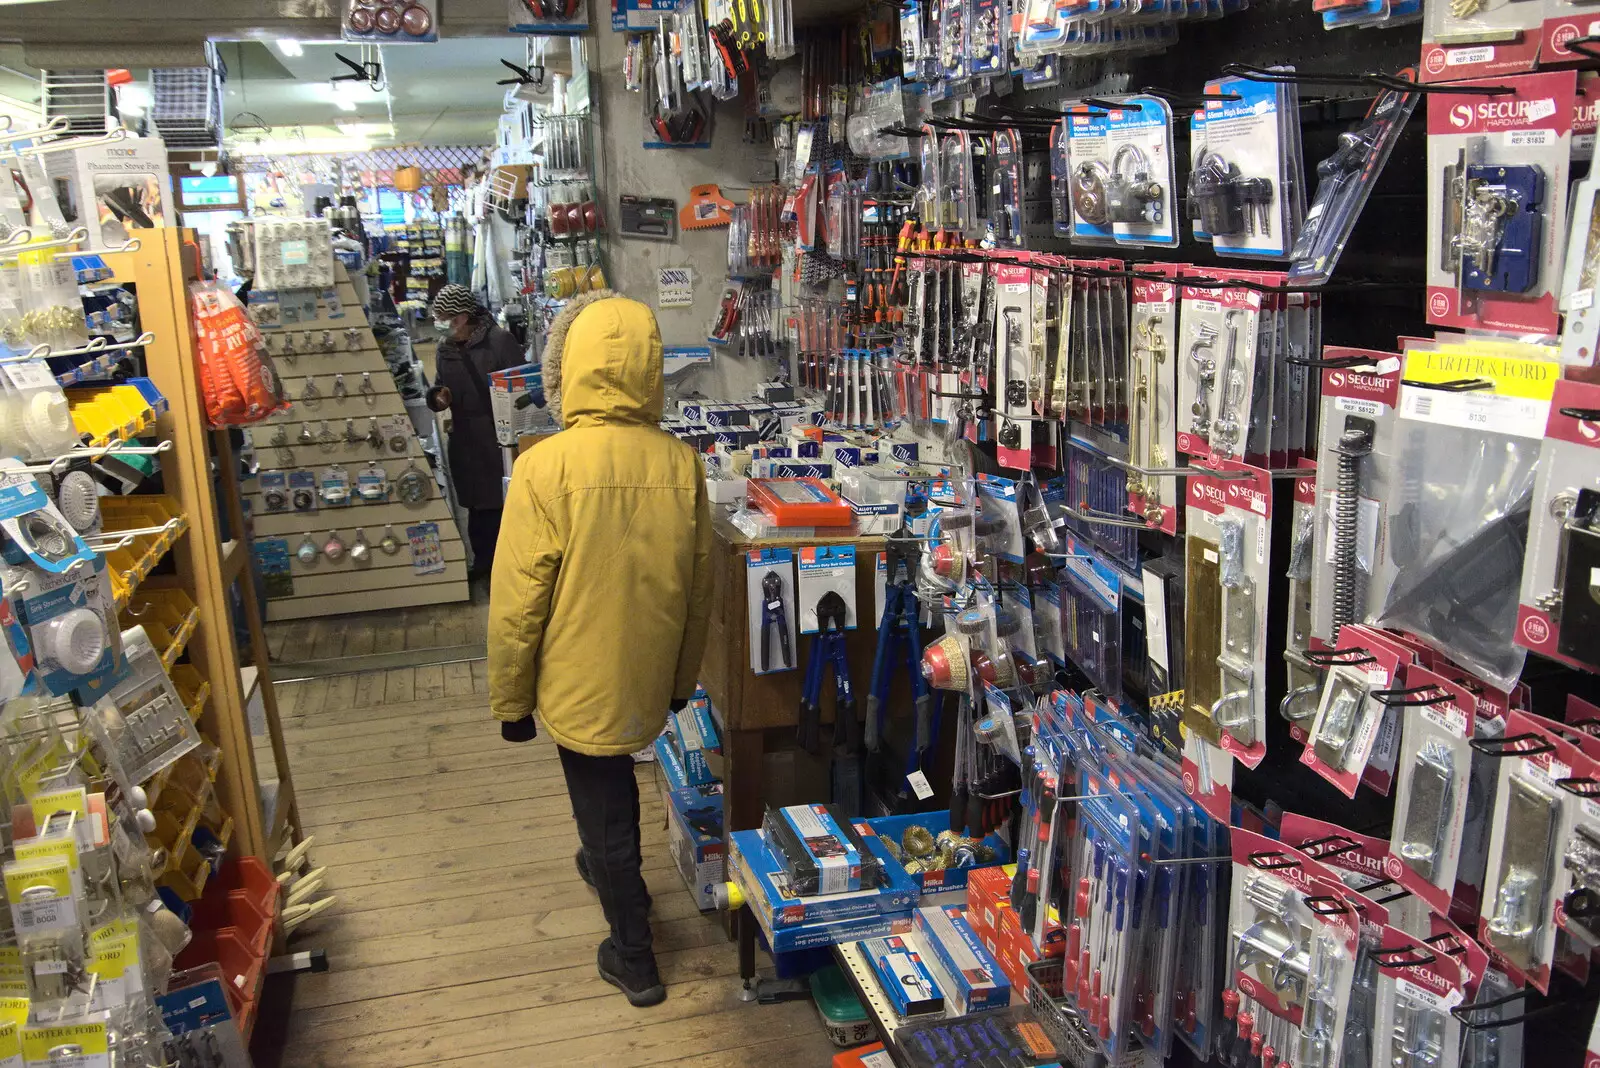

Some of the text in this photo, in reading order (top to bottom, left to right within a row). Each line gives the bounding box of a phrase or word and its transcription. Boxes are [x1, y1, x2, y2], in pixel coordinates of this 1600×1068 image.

[87, 162, 160, 170] Phantom Stove Fan
[1426, 354, 1484, 375] LARTER
[1503, 361, 1547, 381] FORD
[1347, 373, 1392, 389] SECURIT
[1205, 485, 1226, 502] SECU
[38, 571, 82, 592] KitchenCraft
[30, 603, 43, 613] Sink
[1476, 697, 1500, 715] URIT
[13, 872, 38, 881] LARTER
[46, 868, 65, 876] FORD
[924, 879, 943, 887] Hilka
[938, 884, 964, 892] Brushes
[819, 906, 851, 916] Professional
[784, 915, 804, 924] Hilka
[1359, 916, 1385, 935] CURIT
[809, 936, 829, 945] Chisel
[831, 929, 872, 941] Professional
[1406, 964, 1454, 990] SECURIT
[25, 1028, 66, 1040] LARTER
[75, 1025, 103, 1035] FORD
